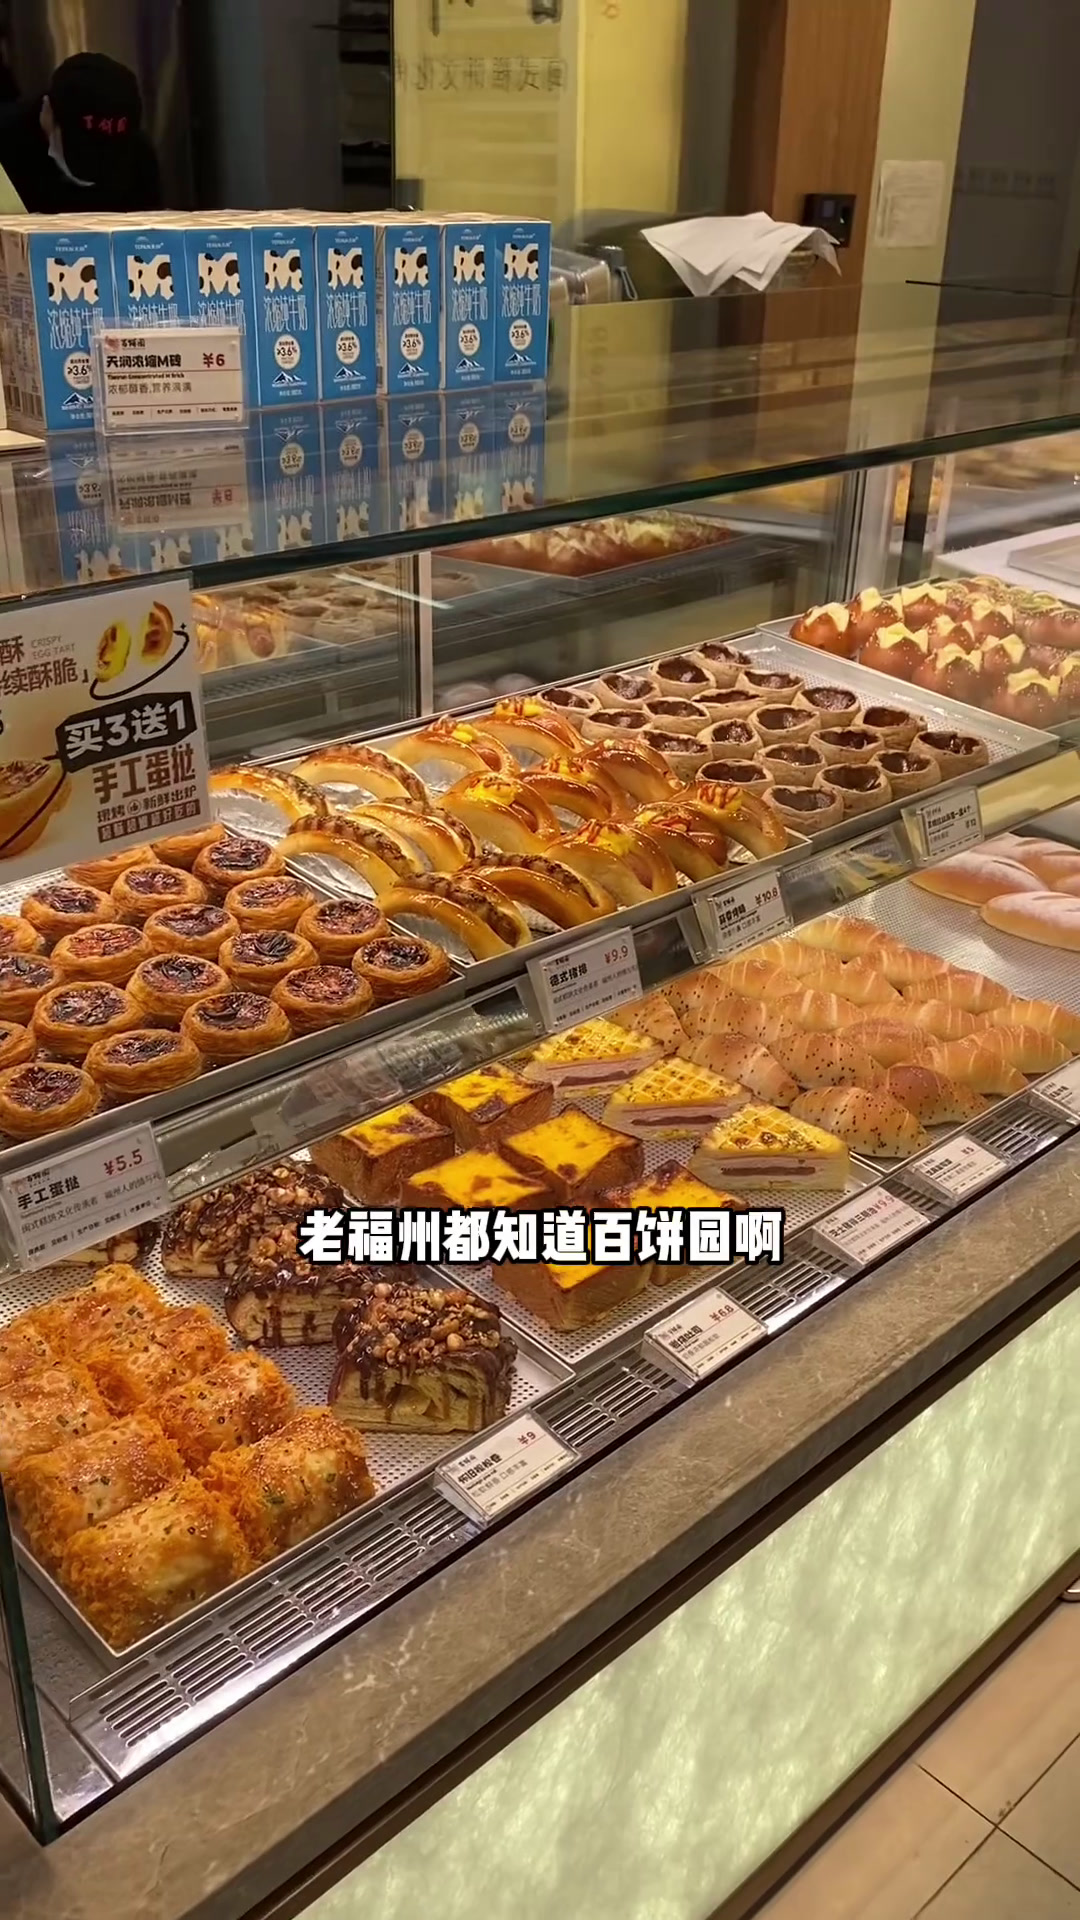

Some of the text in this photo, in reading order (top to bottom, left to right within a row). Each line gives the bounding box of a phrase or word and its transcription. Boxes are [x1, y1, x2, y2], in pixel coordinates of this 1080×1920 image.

[107, 353, 225, 368] 天润浓缩M砖 ¥6
[31, 636, 61, 649] CRISPY
[33, 643, 76, 659] EGG TART
[65, 701, 187, 760] 买3送1
[92, 743, 196, 804] 手工蛋挞
[143, 785, 197, 810] 新鲜出炉
[605, 945, 628, 964] ¥9.9
[18, 1175, 80, 1210] 手工蛋挞
[104, 1149, 143, 1176] ¥5.5
[518, 1431, 536, 1445] ¥9
